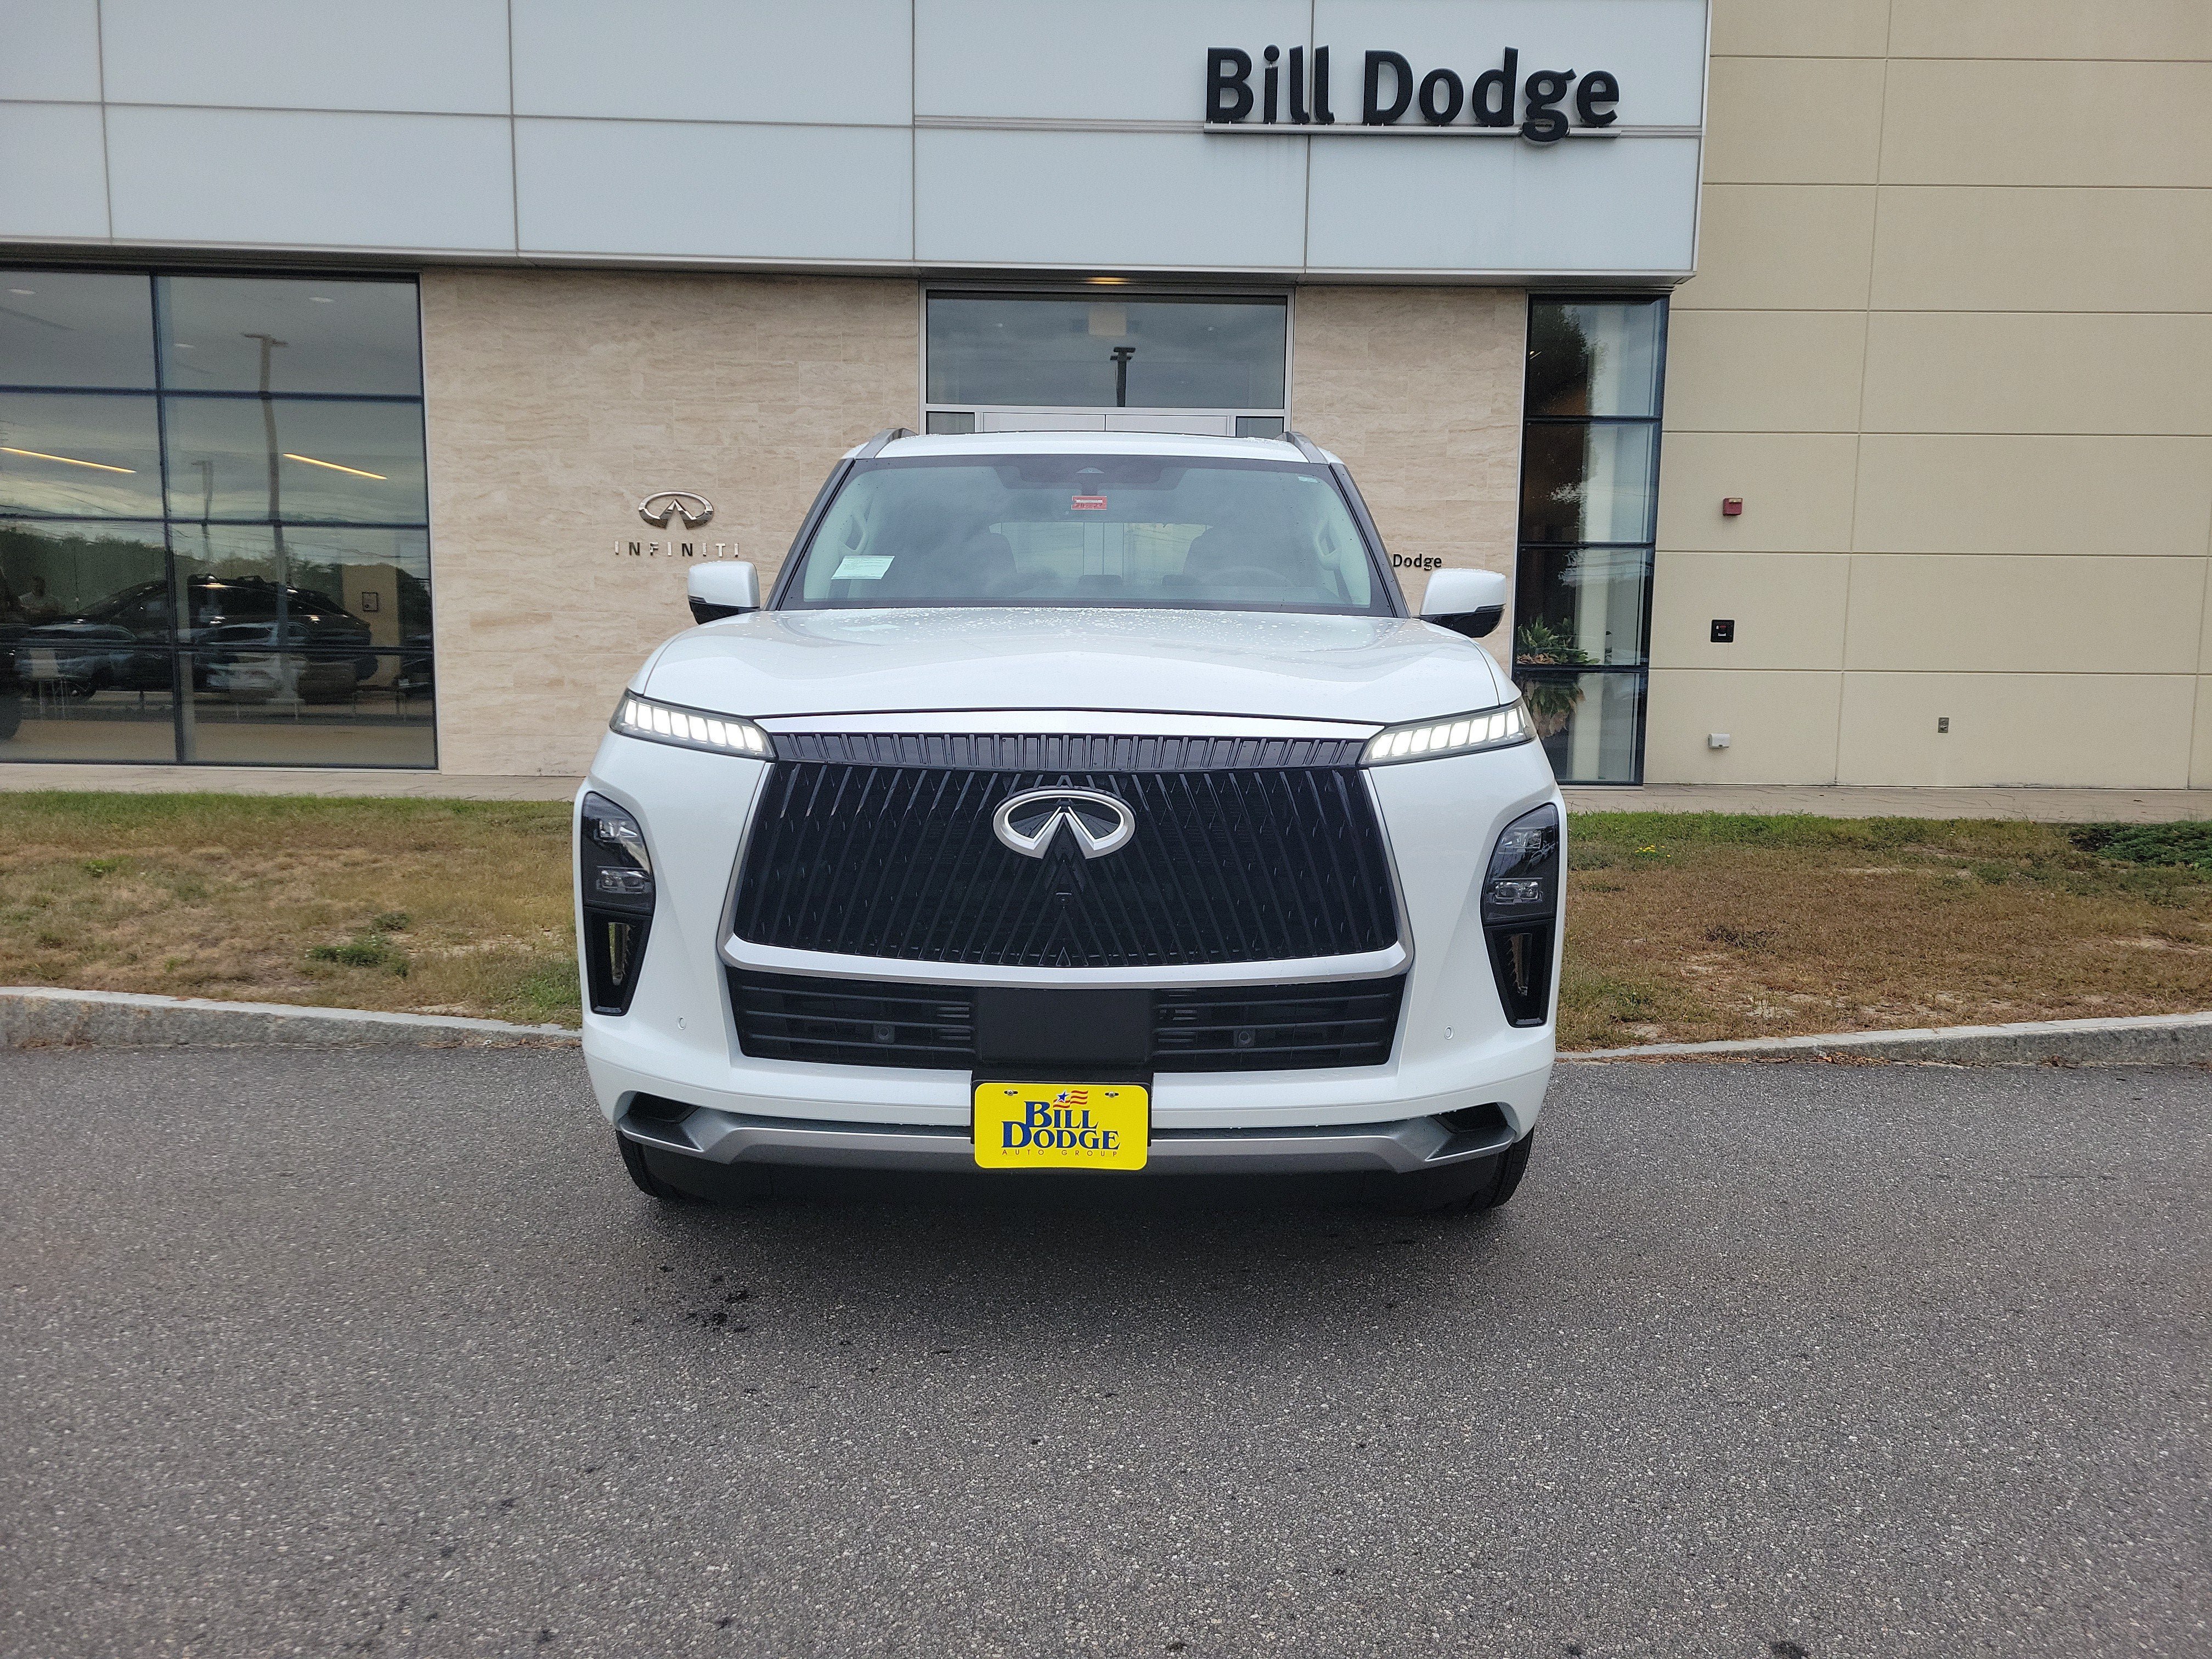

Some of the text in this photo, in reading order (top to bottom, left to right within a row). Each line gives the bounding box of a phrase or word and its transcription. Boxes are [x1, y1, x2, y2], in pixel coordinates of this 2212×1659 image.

[1206, 44, 1620, 142] Bill Dodge
[614, 540, 739, 557] INFINITI
[1393, 553, 1442, 571] Dodge
[1024, 1101, 1099, 1129] BILL
[1001, 1121, 1120, 1150] DODGE
